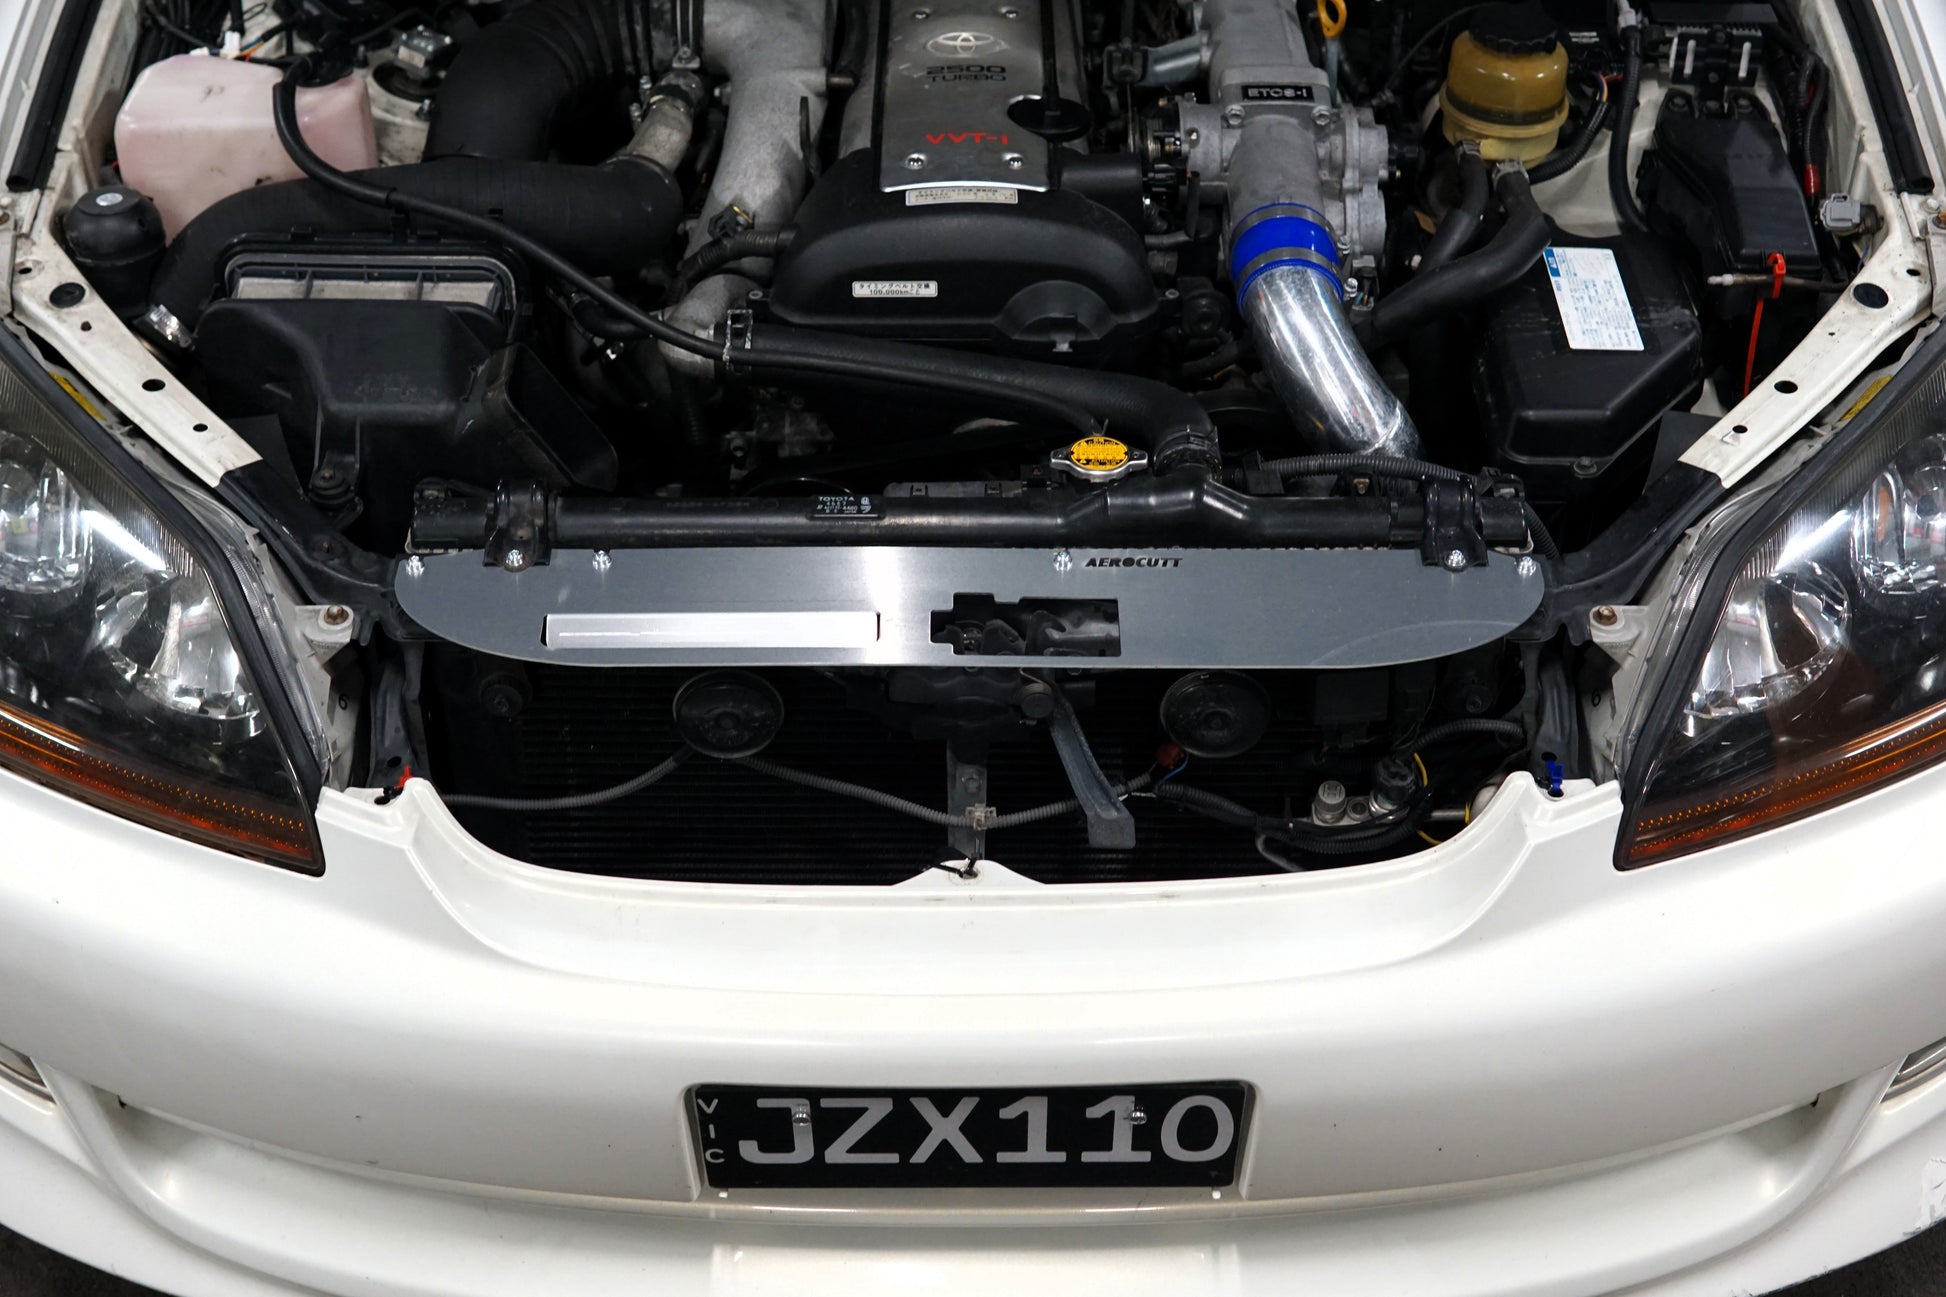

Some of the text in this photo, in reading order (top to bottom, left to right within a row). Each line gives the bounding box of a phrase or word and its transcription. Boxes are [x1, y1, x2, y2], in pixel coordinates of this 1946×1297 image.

[926, 65, 1006, 75] 2500
[926, 74, 1006, 82] TURBO
[1085, 557, 1183, 568] AEROCUTT
[738, 1095, 1235, 1165] JZX110
